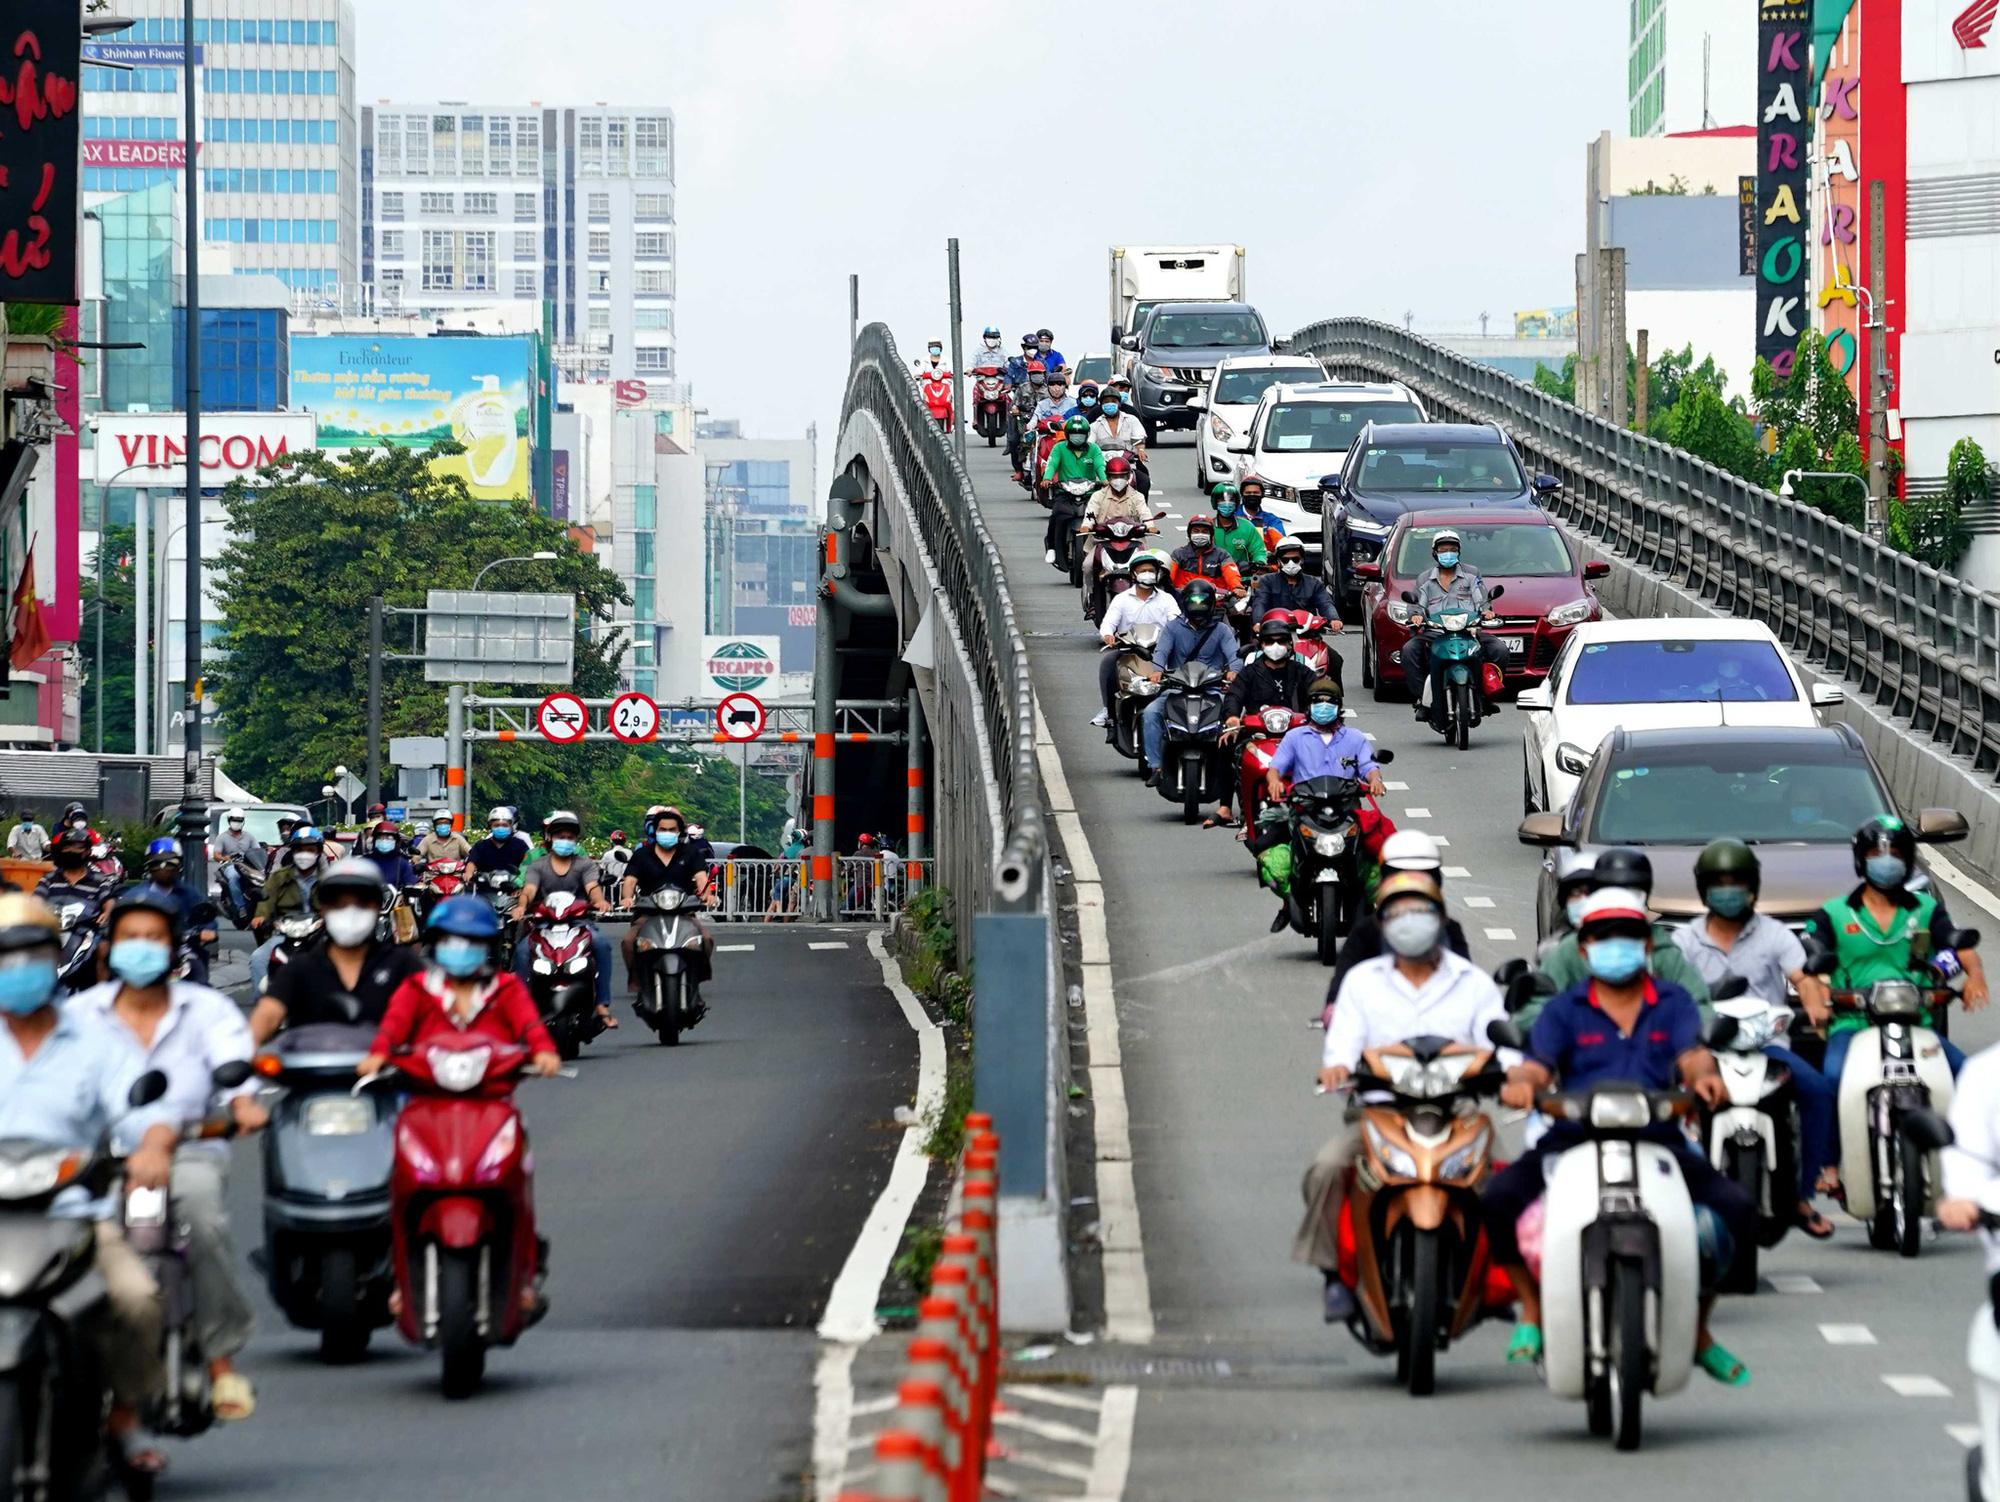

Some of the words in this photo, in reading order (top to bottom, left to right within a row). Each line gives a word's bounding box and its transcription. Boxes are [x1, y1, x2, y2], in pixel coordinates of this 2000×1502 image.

[102, 47, 146, 59] Shinhan
[149, 47, 186, 60] Financ
[339, 349, 413, 366] Enchanteur
[115, 434, 294, 469] VINCOM
[555, 477, 566, 511] TPBank
[707, 659, 774, 675] TECAPRO
